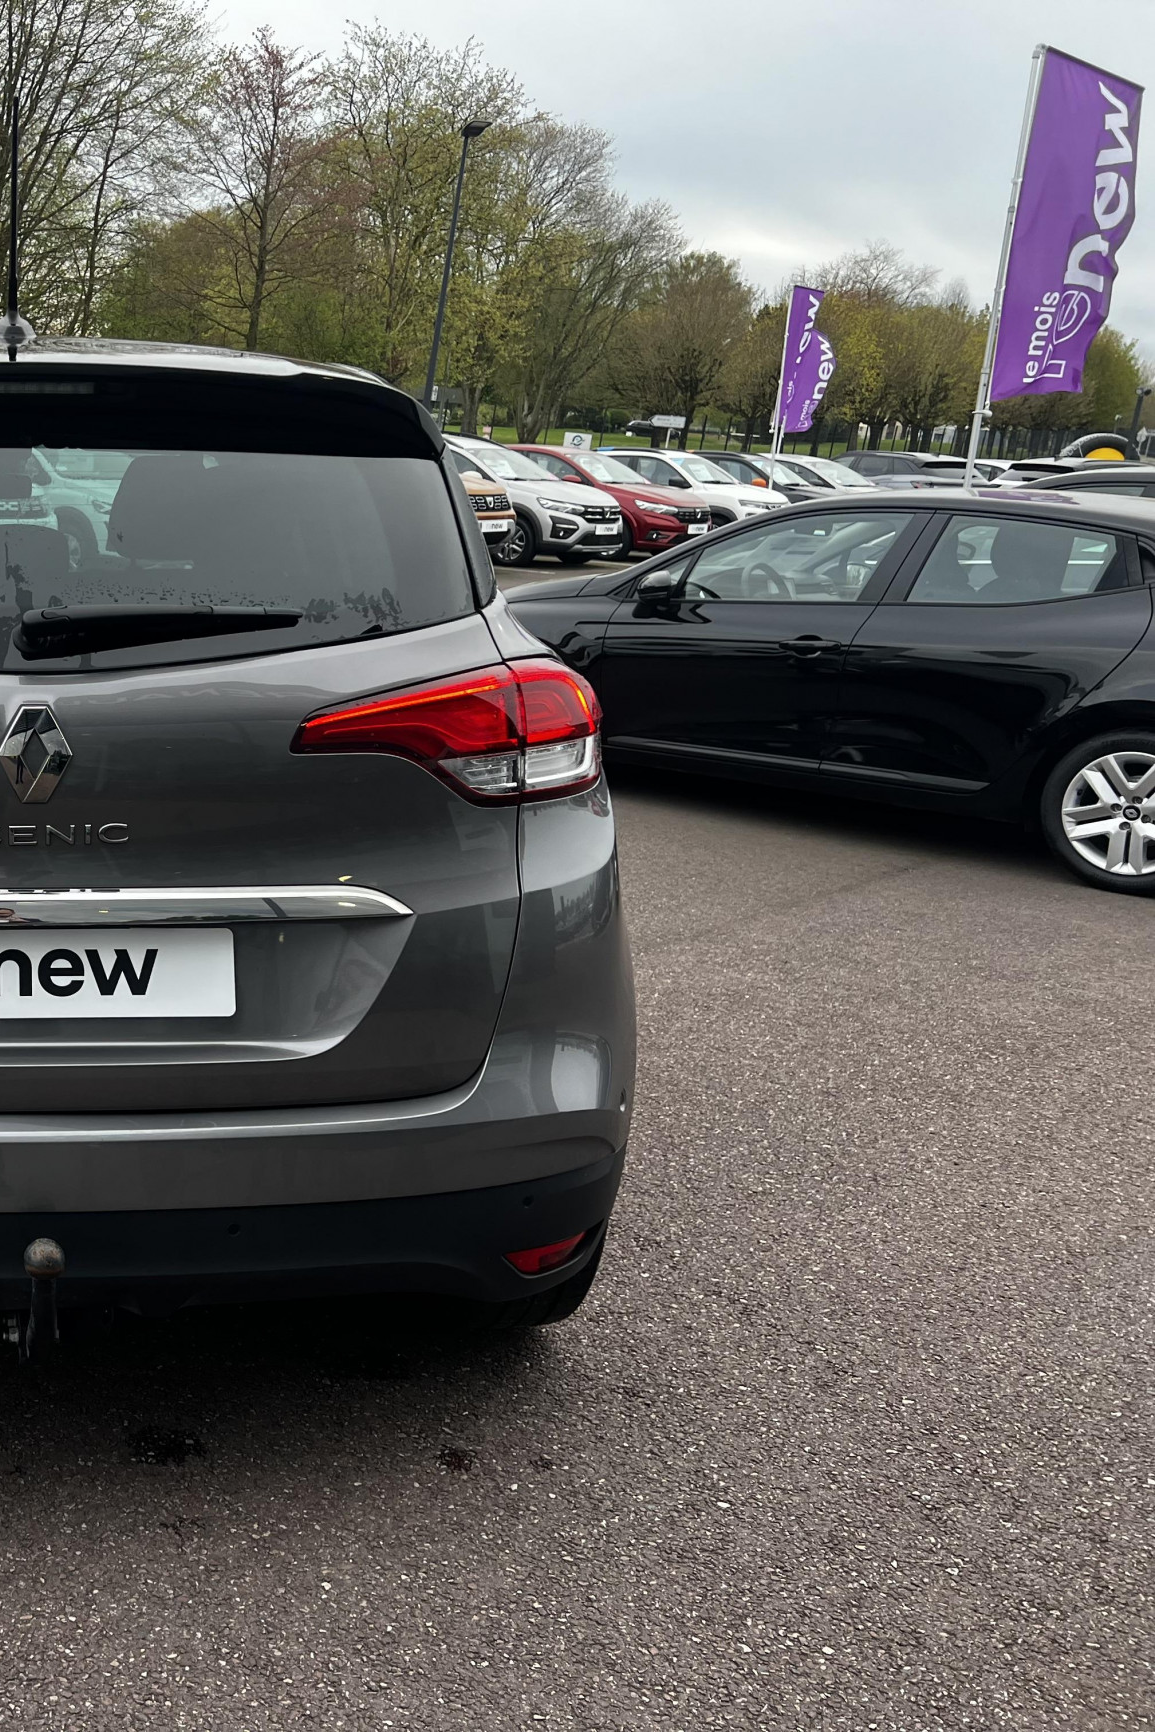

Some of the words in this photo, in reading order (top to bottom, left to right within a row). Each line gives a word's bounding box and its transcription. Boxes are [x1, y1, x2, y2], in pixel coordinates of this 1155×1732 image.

[1034, 80, 1133, 378] renew
[1026, 290, 1061, 359] mois
[1022, 361, 1039, 384] le
